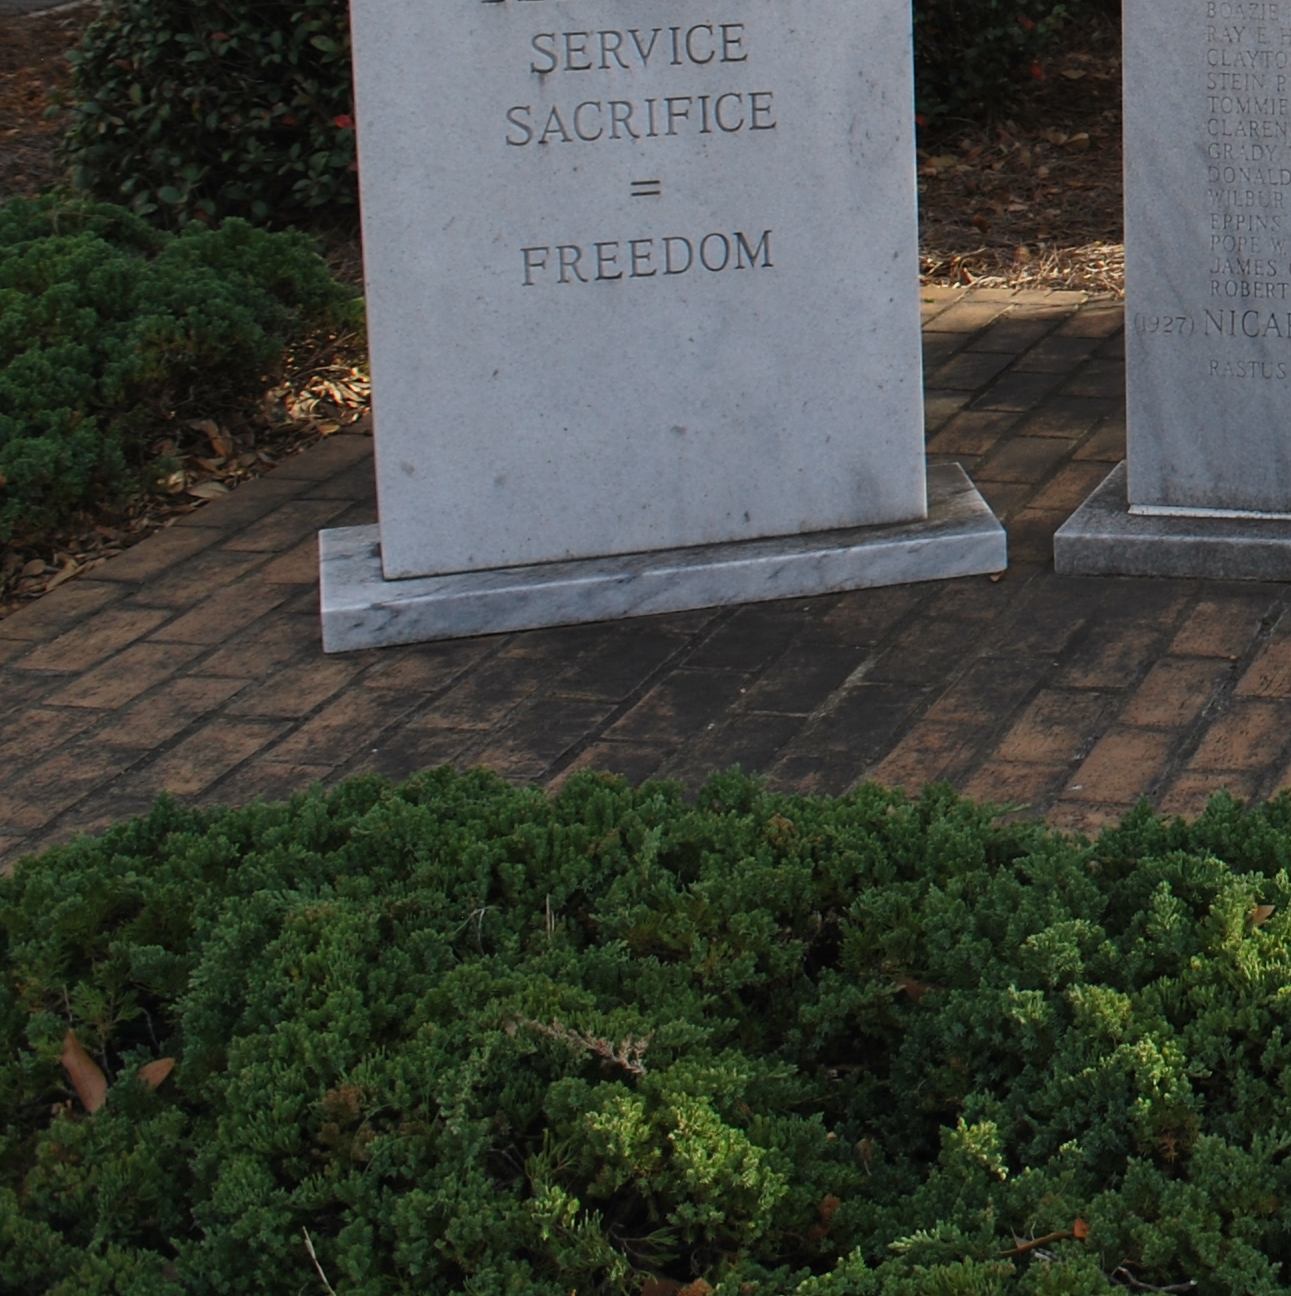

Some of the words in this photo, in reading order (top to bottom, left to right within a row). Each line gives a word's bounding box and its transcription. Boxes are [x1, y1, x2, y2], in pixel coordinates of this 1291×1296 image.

[1207, 26, 1245, 44] RAY
[530, 23, 749, 75] SERVICE
[1207, 73, 1265, 92] STEIN
[1207, 97, 1289, 115] TOMMIE
[505, 91, 777, 147] SACRIFICE
[1208, 144, 1278, 162] GRADY
[1208, 165, 1291, 185] DONALD
[1208, 189, 1284, 208] WILBUR
[1211, 213, 1281, 232] EPPINS
[1211, 234, 1260, 253] POPE
[521, 229, 774, 286] FREEDOM
[1210, 258, 1277, 277] JAMES
[1210, 281, 1289, 301] ROBERT
[1134, 312, 1195, 337] (1927)
[1209, 359, 1287, 381] RASTUS
